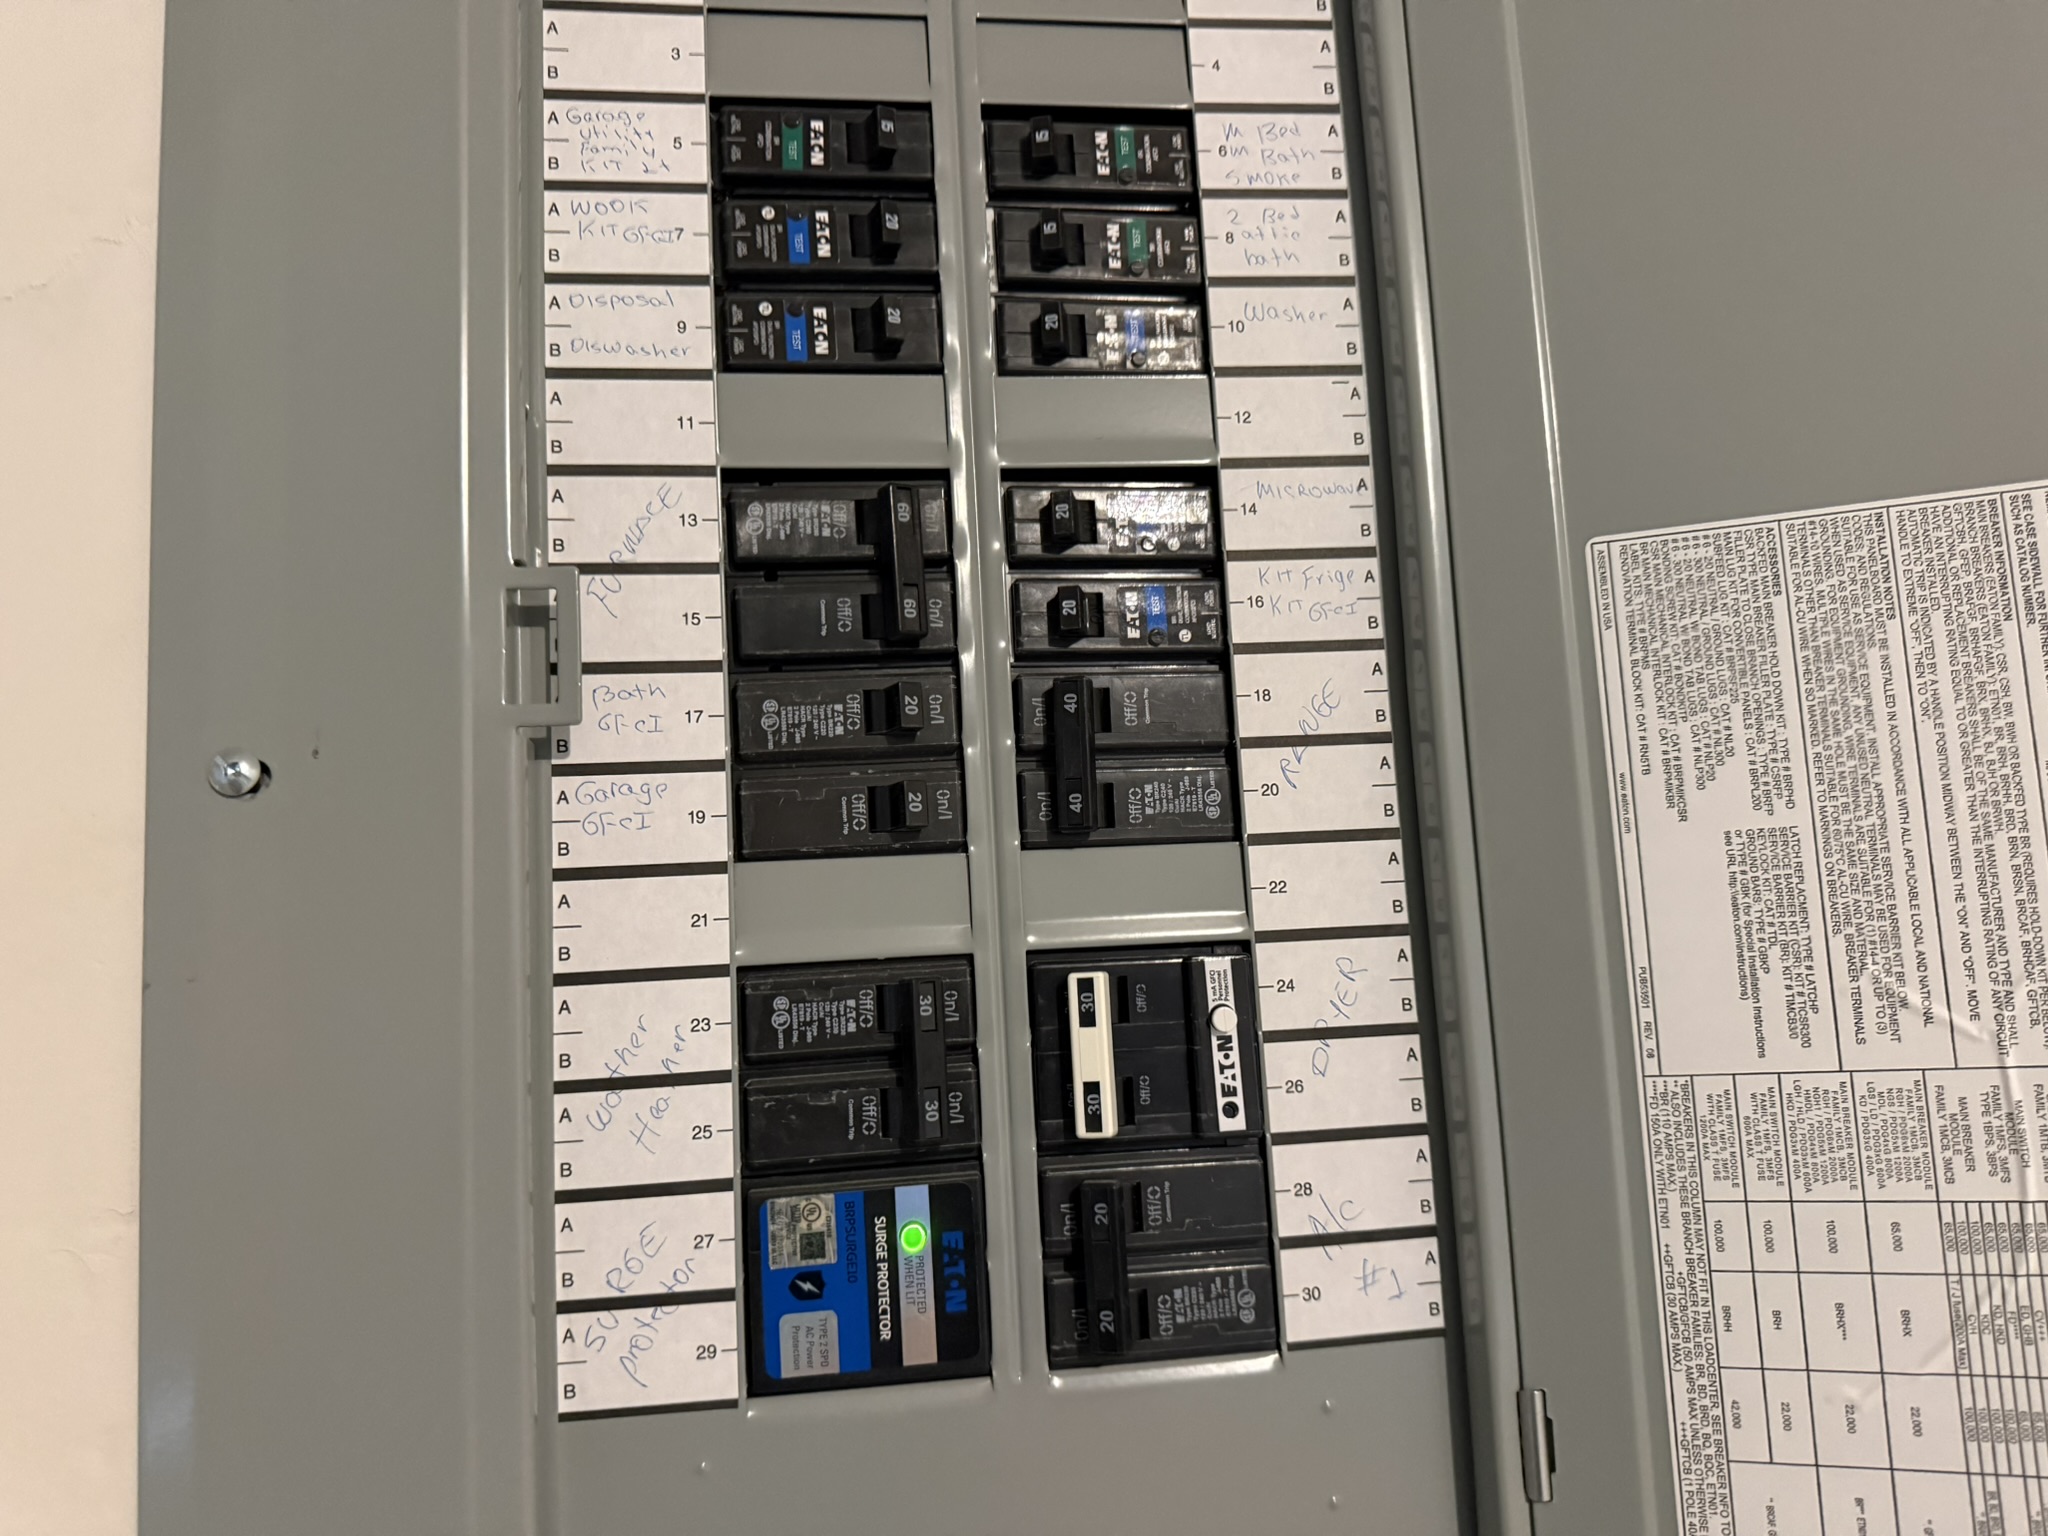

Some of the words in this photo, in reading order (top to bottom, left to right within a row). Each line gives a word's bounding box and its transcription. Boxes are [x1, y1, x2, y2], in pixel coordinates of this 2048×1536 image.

[547, 21, 558, 34] A
[672, 48, 680, 60] 3
[1321, 40, 1330, 52] A
[548, 66, 558, 79] B
[1212, 60, 1221, 71] 4
[1324, 82, 1334, 94] B
[566, 107, 646, 127] Garage
[1257, 122, 1301, 144] Bed
[674, 137, 682, 149] 5
[1219, 145, 1227, 157] 6
[886, 213, 899, 229] 20
[1227, 209, 1240, 225] 2
[1263, 206, 1300, 224] Bed
[675, 228, 684, 240] 7
[1226, 232, 1234, 244] 8
[549, 296, 560, 309] A
[1343, 298, 1353, 310] A
[888, 308, 901, 324] 20
[1243, 301, 1329, 323] Washer
[677, 321, 686, 333] 9
[1045, 314, 1059, 329] 20
[1229, 320, 1244, 333] 10
[550, 344, 561, 356] B
[1347, 342, 1357, 355] B
[678, 416, 692, 429] 11
[1235, 411, 1251, 423] 12
[897, 501, 910, 522] 60
[1056, 503, 1069, 519] 20
[1241, 503, 1257, 515] 14
[2009, 495, 2021, 521] SUCH
[680, 514, 697, 527] 13
[2013, 524, 2023, 535] AS
[1765, 527, 1782, 597] ACCESSORIES
[1874, 511, 1892, 584] INSTALLATION
[1883, 586, 1896, 620] NOTES
[1988, 498, 2002, 548] BREAKER
[1995, 550, 2013, 621] INFORMATION
[2015, 538, 2029, 583] CATALOG
[1596, 550, 1609, 600] ASSEMBLED
[903, 599, 917, 618] 60
[1062, 600, 1076, 616] 20
[1151, 595, 1161, 616] TEST
[1247, 596, 1264, 608] 16
[1603, 602, 1610, 611] IN
[683, 612, 700, 625] 15
[1603, 613, 1612, 631] USA
[593, 682, 666, 707] Bath
[1254, 689, 1271, 701] 18
[904, 695, 918, 716] 20
[1063, 693, 1077, 714] 40
[685, 710, 703, 723] 17
[575, 781, 668, 805] Garage
[1261, 783, 1279, 796] 20
[908, 791, 922, 812] 20
[1068, 792, 1083, 814] 40
[688, 810, 705, 824] 19
[1389, 852, 1399, 865] A
[1269, 881, 1287, 893] 22
[1393, 900, 1404, 913] B
[691, 914, 707, 927] 21
[1277, 979, 1295, 992] 24
[919, 995, 932, 1016] 30
[1081, 991, 1094, 1013] 30
[691, 1018, 711, 1032] 23
[1286, 1080, 1304, 1093] 26
[924, 1101, 938, 1122] 30
[1088, 1093, 1101, 1116] 30
[692, 1125, 712, 1140] 25
[1294, 1182, 1312, 1196] 28
[1094, 1202, 1108, 1226] 20
[694, 1234, 714, 1249] 27
[874, 1216, 887, 1260] SURGE
[1713, 1219, 1725, 1252] 100,000
[1890, 1221, 1903, 1251] 65,000
[1425, 1251, 1436, 1264] A
[904, 1256, 914, 1289] WHEN
[942, 1231, 968, 1313] EATON
[915, 1255, 927, 1314] PROTECTED
[906, 1290, 915, 1306] LIT
[1303, 1286, 1321, 1301] 30
[877, 1263, 892, 1341] PROTECTOR
[1429, 1303, 1440, 1316] B
[1100, 1310, 1114, 1332] 20
[1721, 1305, 1733, 1332] BRHH
[1772, 1310, 1782, 1330] BRH
[1900, 1309, 1912, 1337] BRHX
[563, 1328, 575, 1343] A
[805, 1326, 814, 1336] AC
[818, 1318, 827, 1341] TYPE
[697, 1344, 716, 1360] 29
[792, 1325, 800, 1370] Protection
[806, 1339, 815, 1369] Power
[564, 1384, 576, 1399] B
[1731, 1400, 1742, 1428] 42,000
[1780, 1402, 1792, 1431] 22,000
